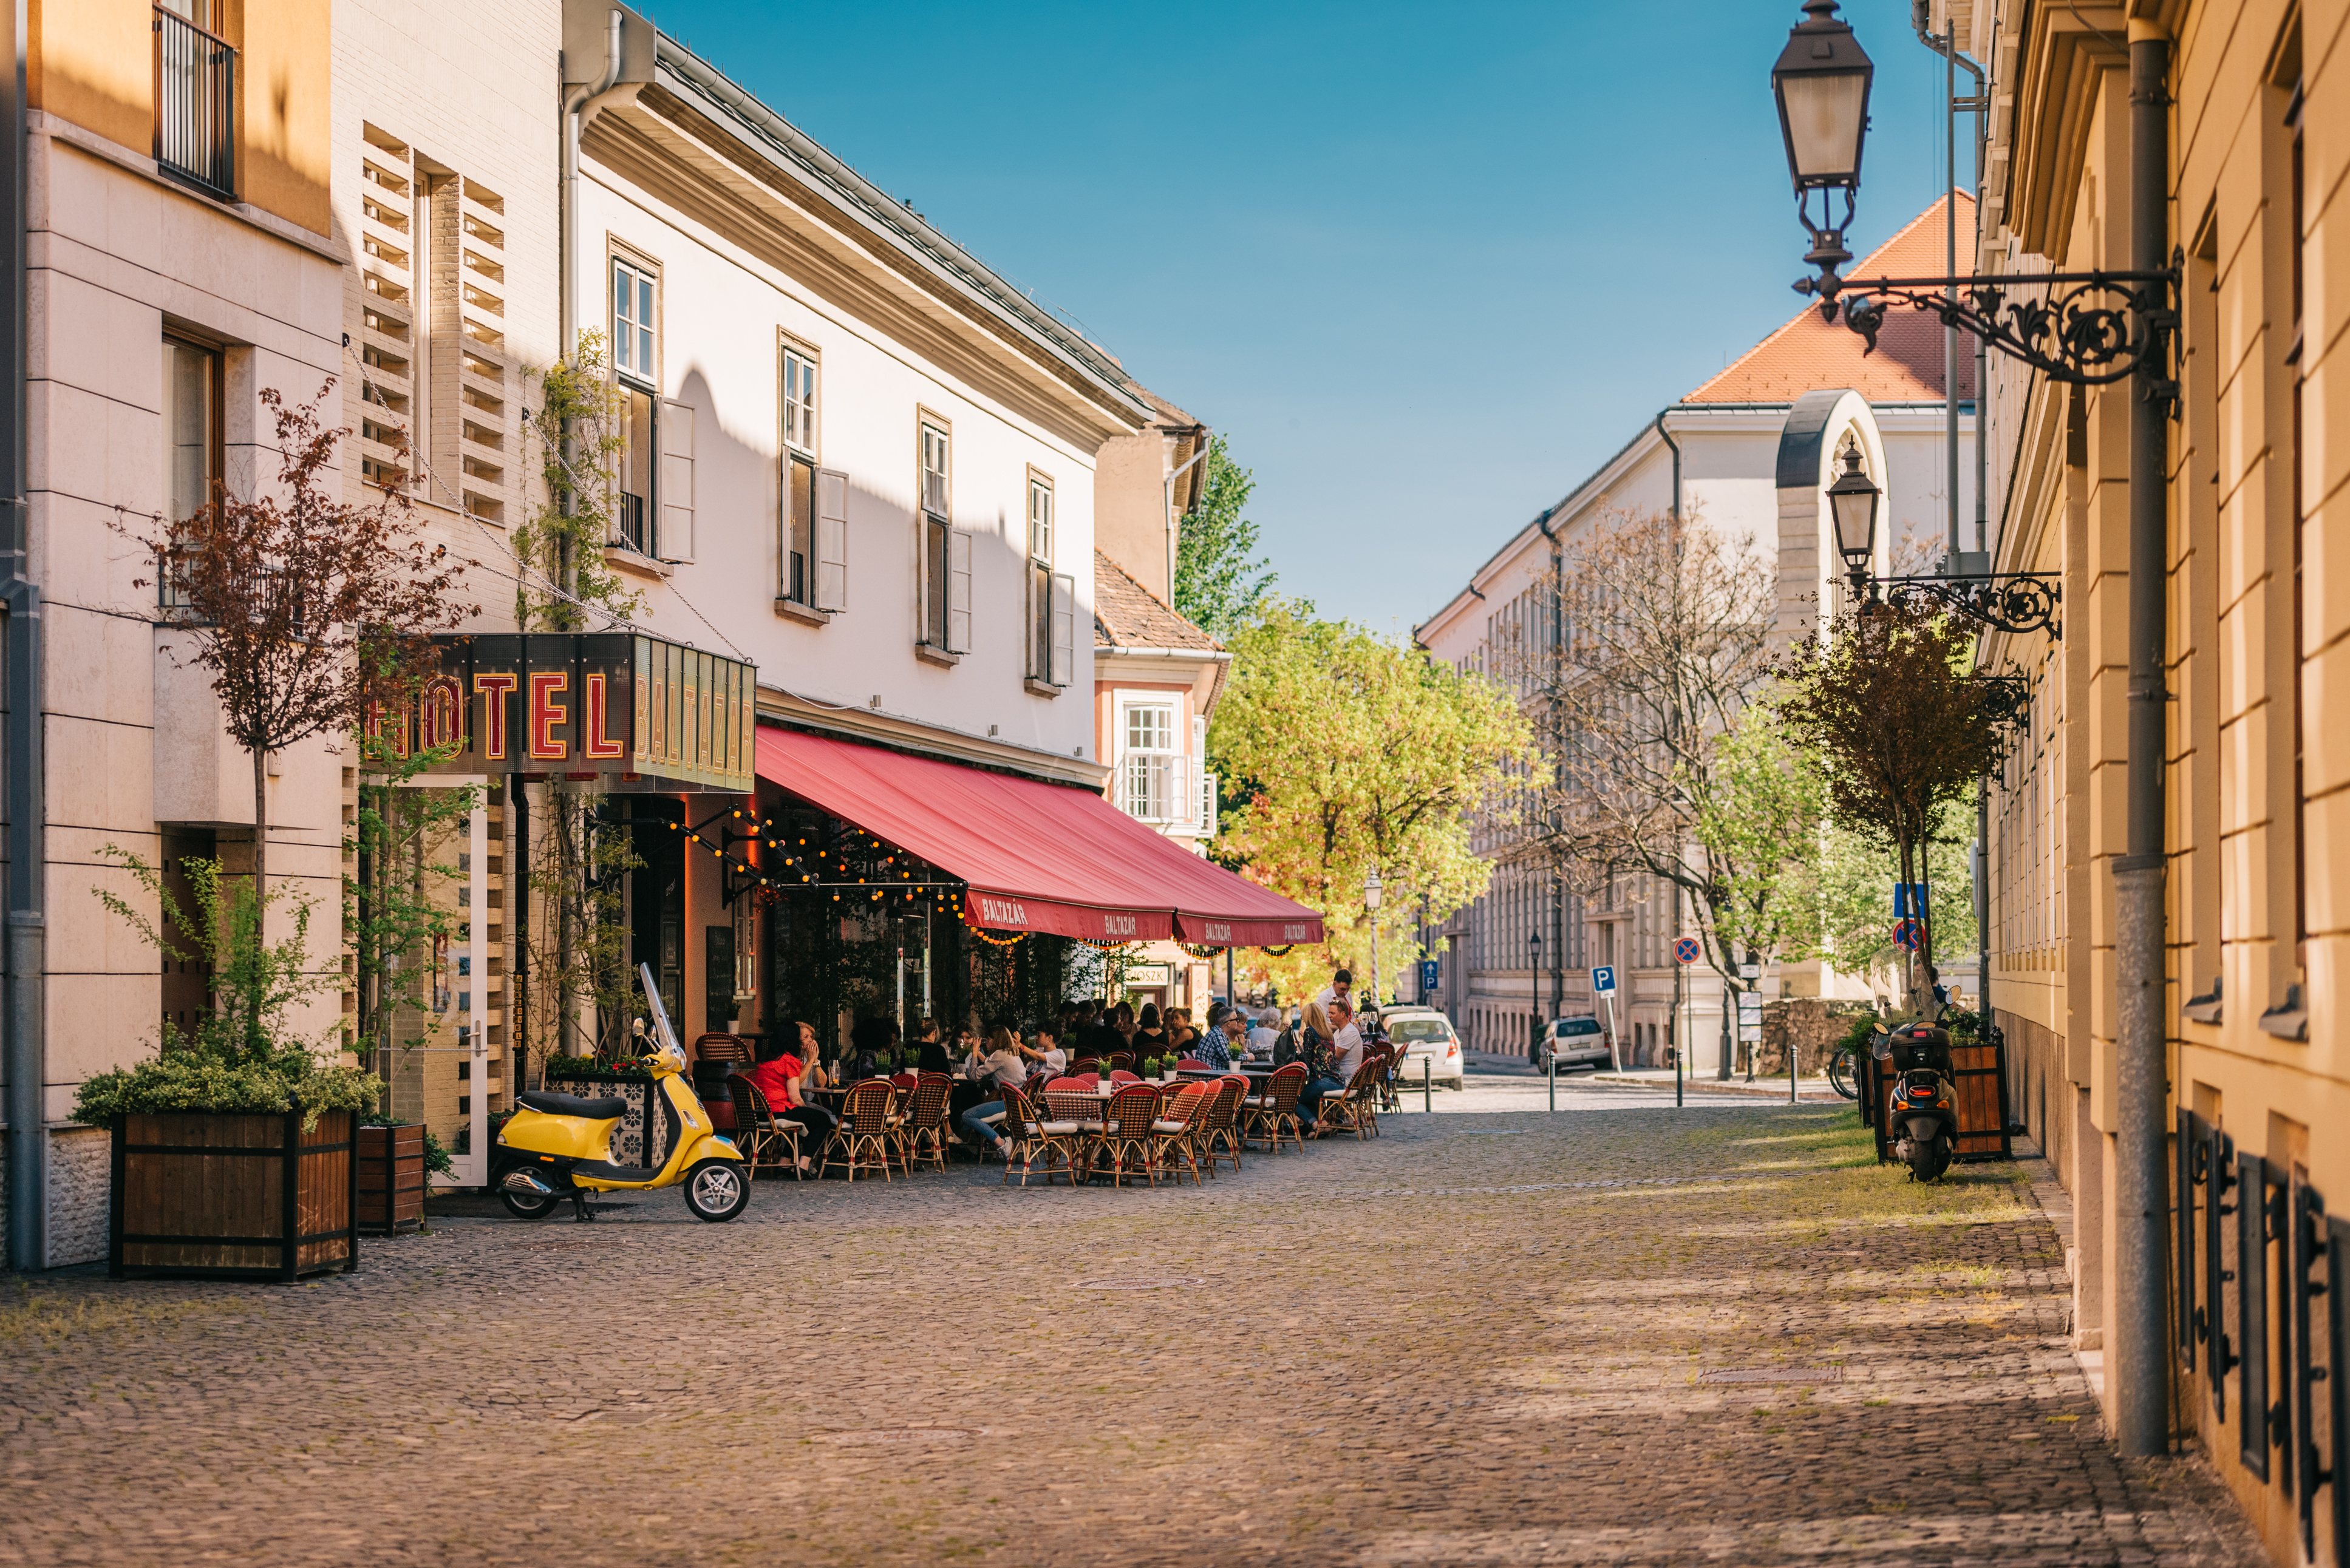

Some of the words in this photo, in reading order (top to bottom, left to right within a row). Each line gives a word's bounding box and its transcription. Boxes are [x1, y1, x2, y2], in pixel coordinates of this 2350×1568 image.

[364, 673, 624, 760] HOTEL
[635, 671, 753, 779] BALTAZÁR
[982, 898, 1029, 925] BALTAZÁR
[1105, 912, 1136, 935] BALTAZÁR
[1205, 921, 1232, 942] BALTAZÁR
[1285, 921, 1306, 940] BALTAZÁR
[1127, 971, 1163, 982] KIOSZK
[1427, 977, 1435, 988] P
[1597, 970, 1609, 988] P
